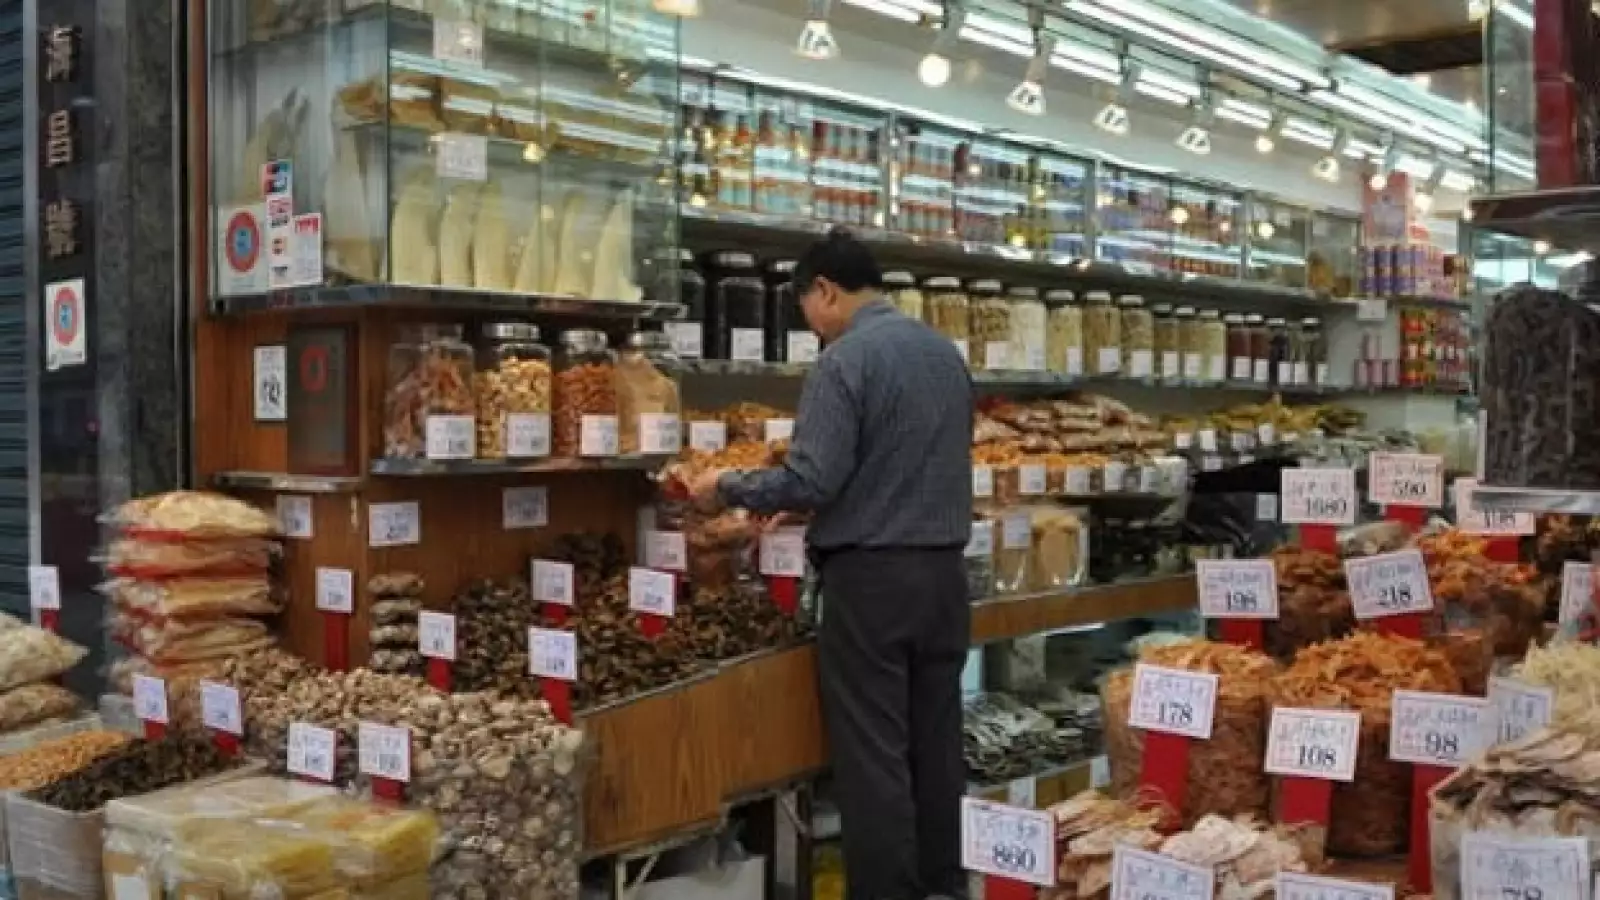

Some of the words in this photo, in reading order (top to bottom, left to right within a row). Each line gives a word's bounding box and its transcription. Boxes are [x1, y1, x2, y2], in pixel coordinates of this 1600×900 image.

[1226, 588, 1259, 612] 198
[1376, 581, 1412, 608] 218
[1158, 700, 1194, 725] 178
[1425, 730, 1460, 754] 98
[1299, 744, 1337, 769] 108
